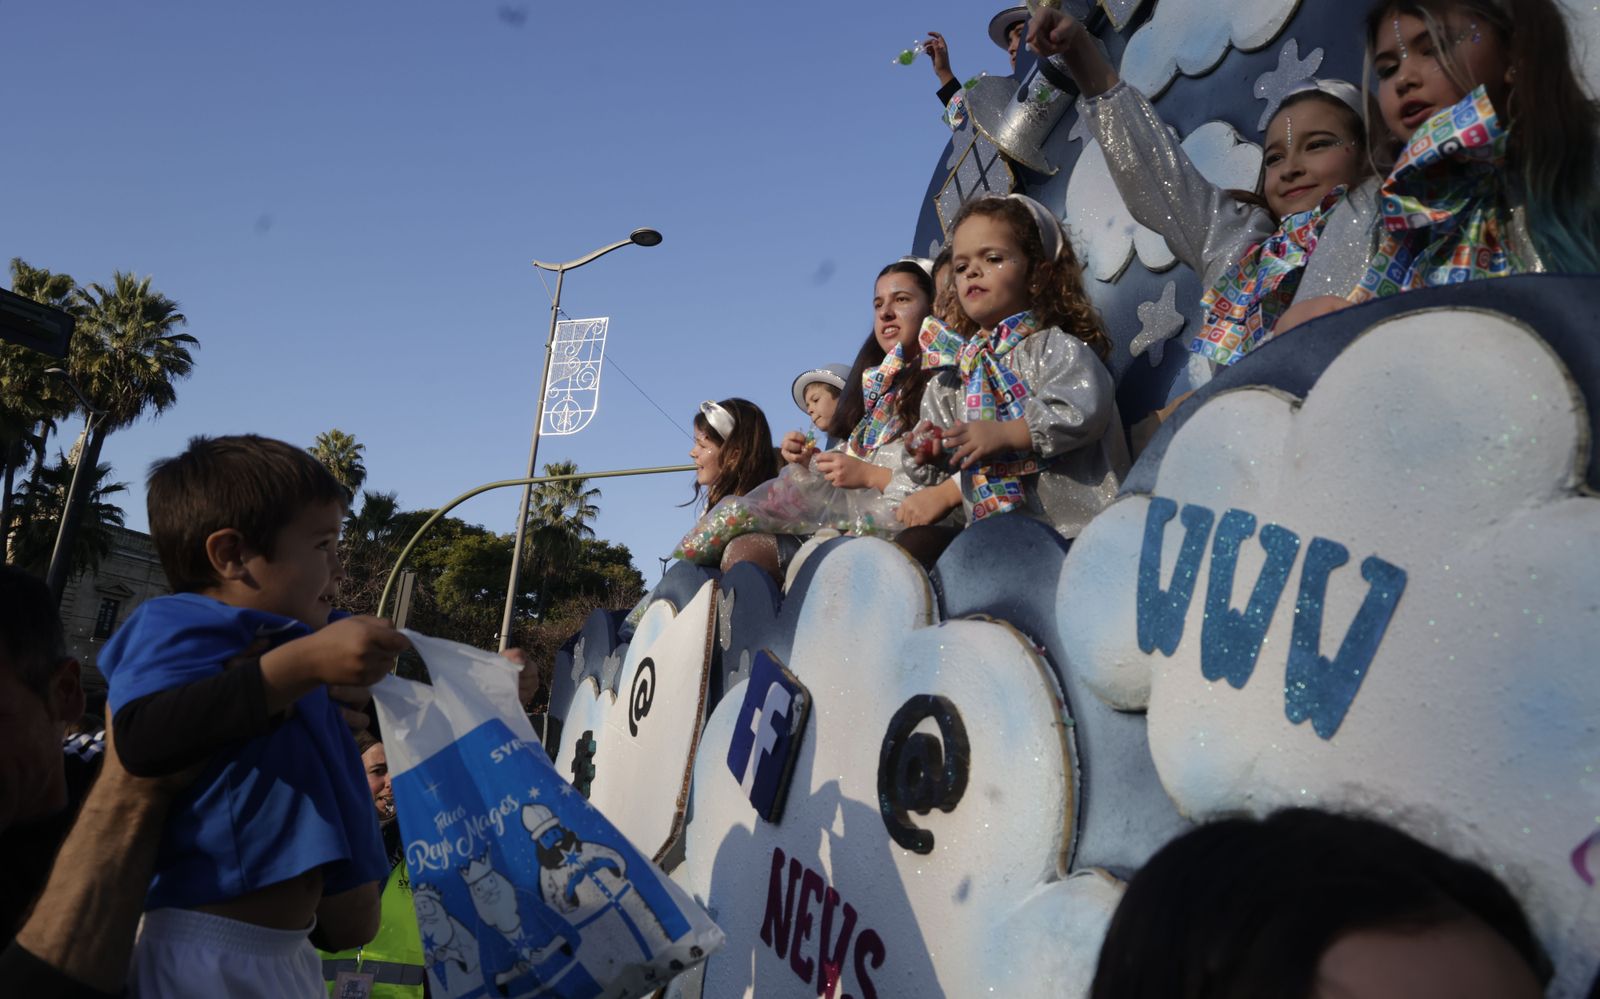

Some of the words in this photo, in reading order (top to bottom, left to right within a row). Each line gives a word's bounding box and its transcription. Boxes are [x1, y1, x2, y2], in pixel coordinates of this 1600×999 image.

[1136, 496, 1407, 741] WWW
[490, 739, 526, 764] SYR
[877, 693, 971, 855] @
[760, 847, 886, 999] NEWS
